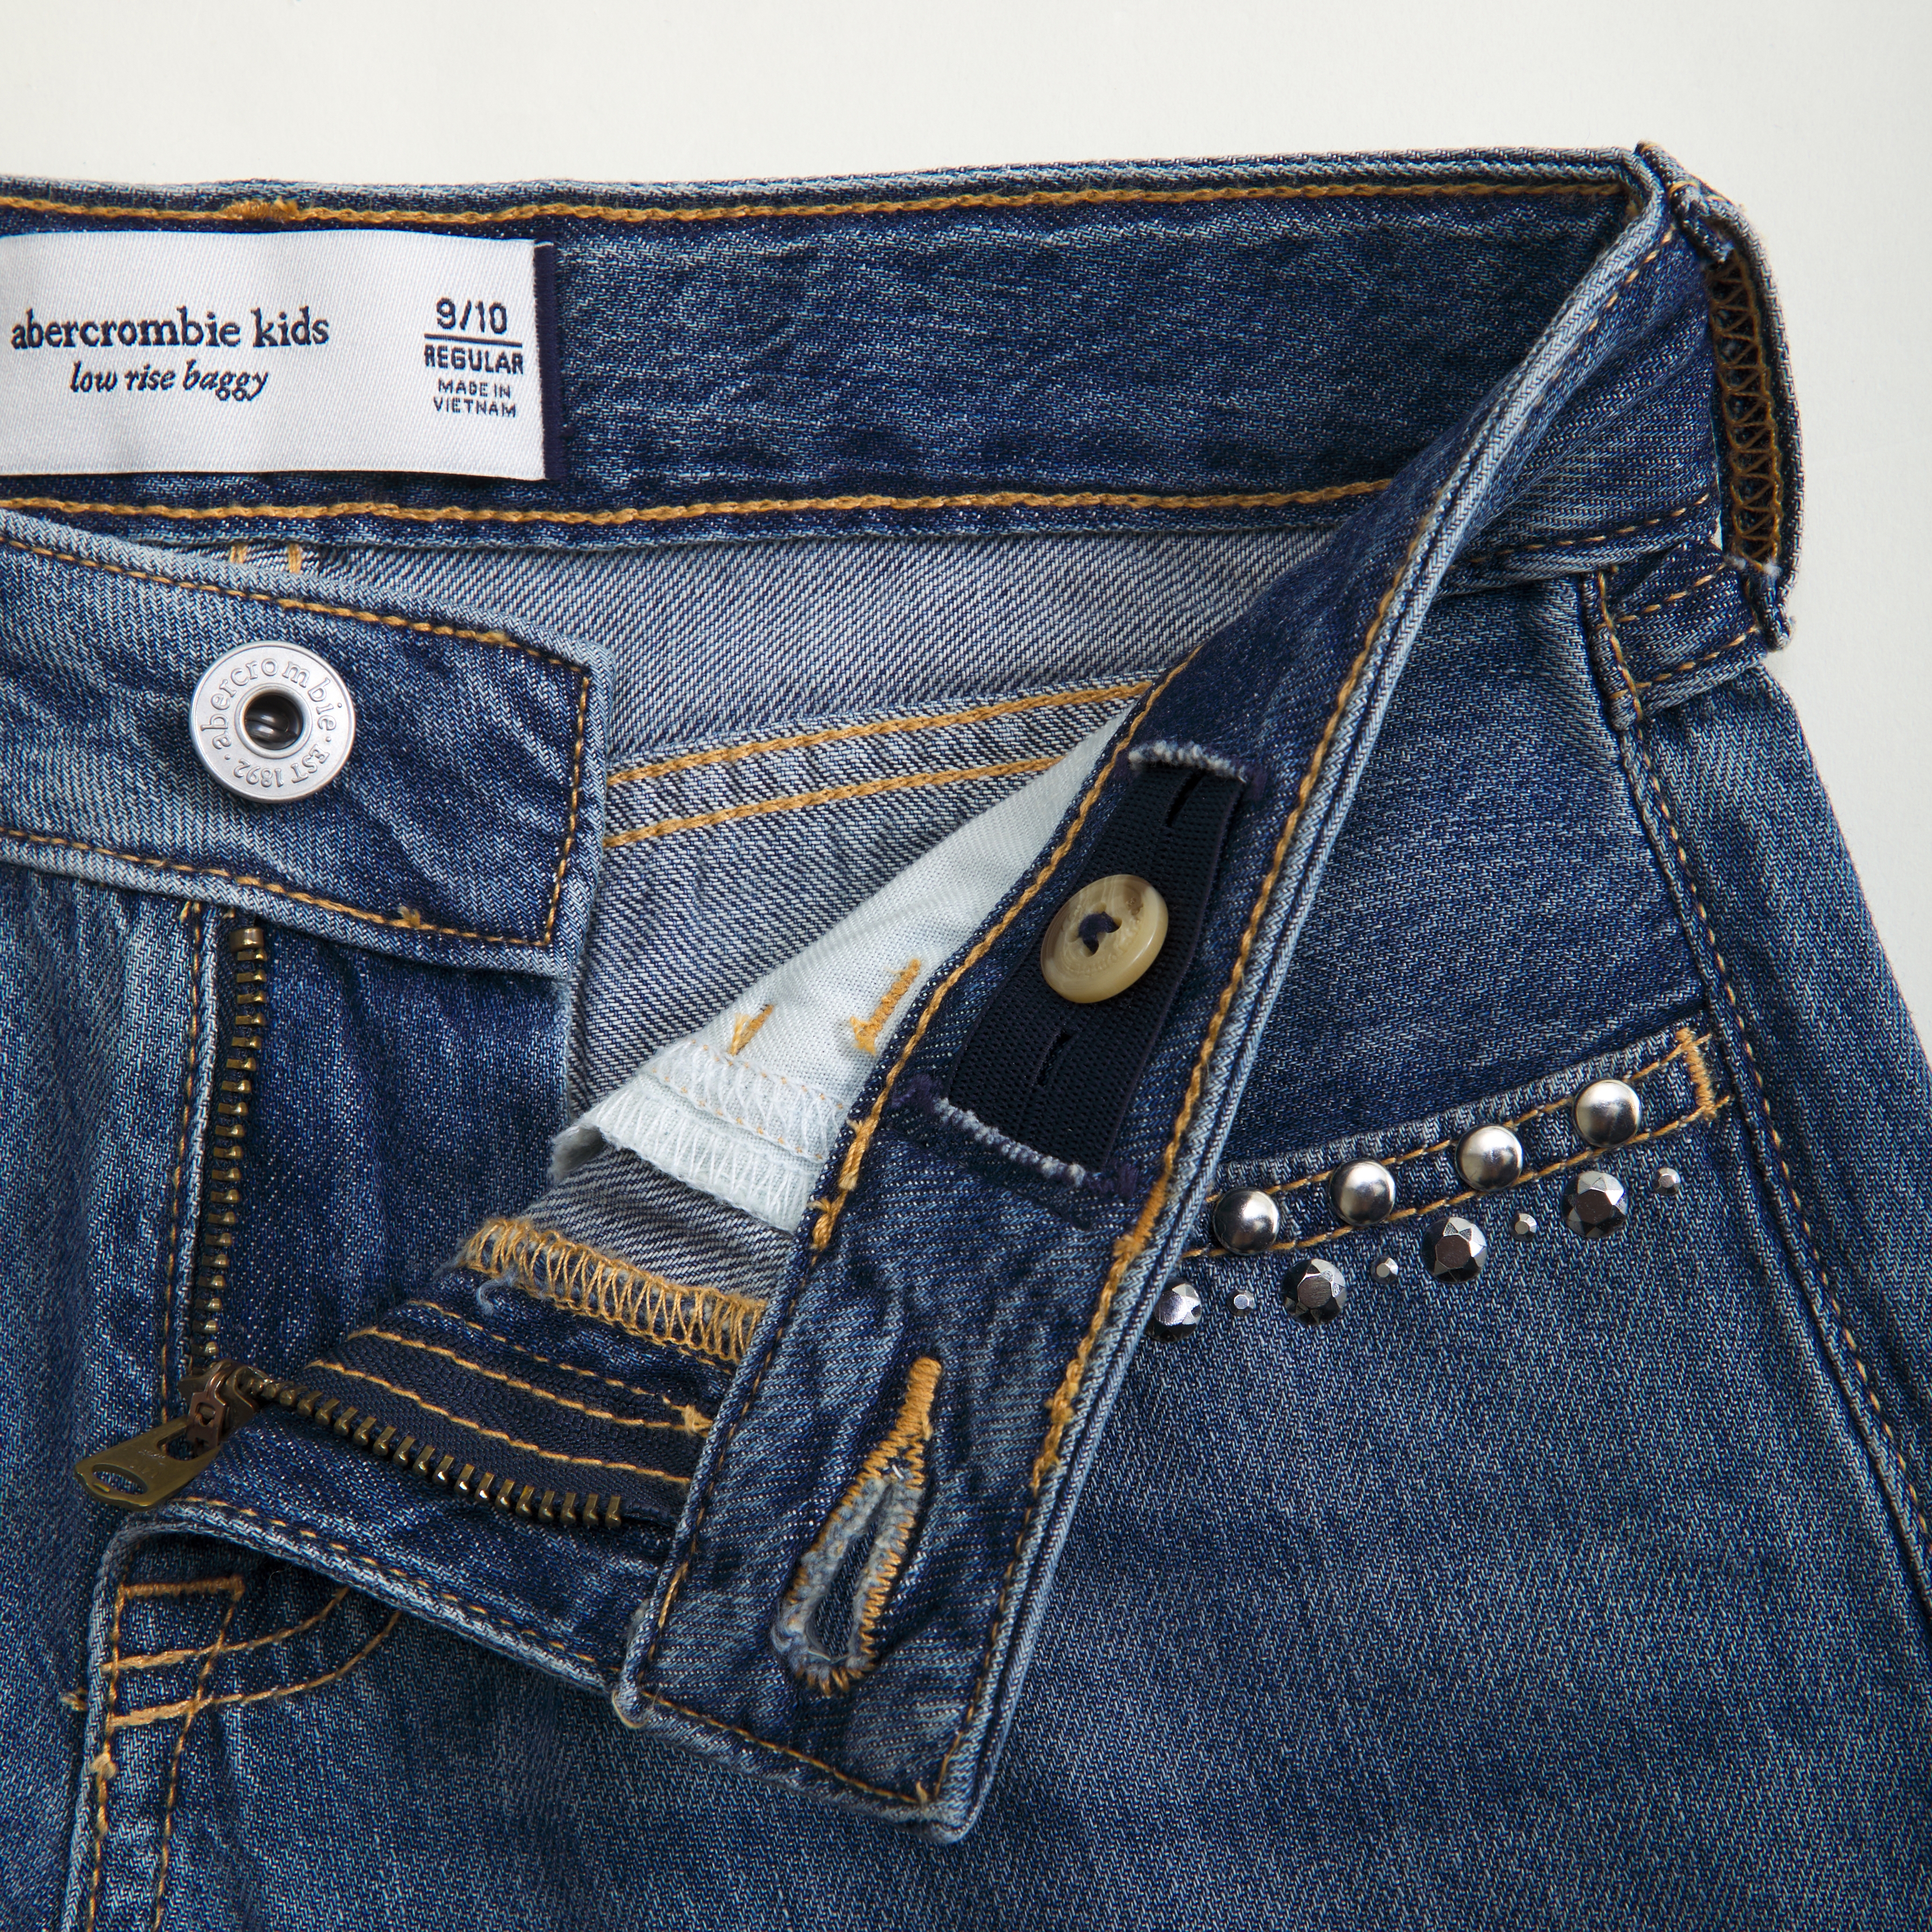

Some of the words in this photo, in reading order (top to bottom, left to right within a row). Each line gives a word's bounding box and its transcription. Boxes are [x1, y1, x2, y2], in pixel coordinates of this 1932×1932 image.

[10, 306, 241, 350] abercrombie
[251, 306, 330, 348] kids
[436, 297, 508, 335] 9/10
[424, 344, 524, 375] REGULAR
[70, 360, 118, 393] low
[124, 362, 176, 391] rise
[182, 359, 269, 402] baggy
[438, 378, 488, 397] MADE
[494, 383, 511, 399] IN
[433, 396, 517, 418] VIETNAM
[200, 658, 343, 750] abercrombie
[233, 758, 285, 788] 1892
[290, 743, 331, 784] EST
